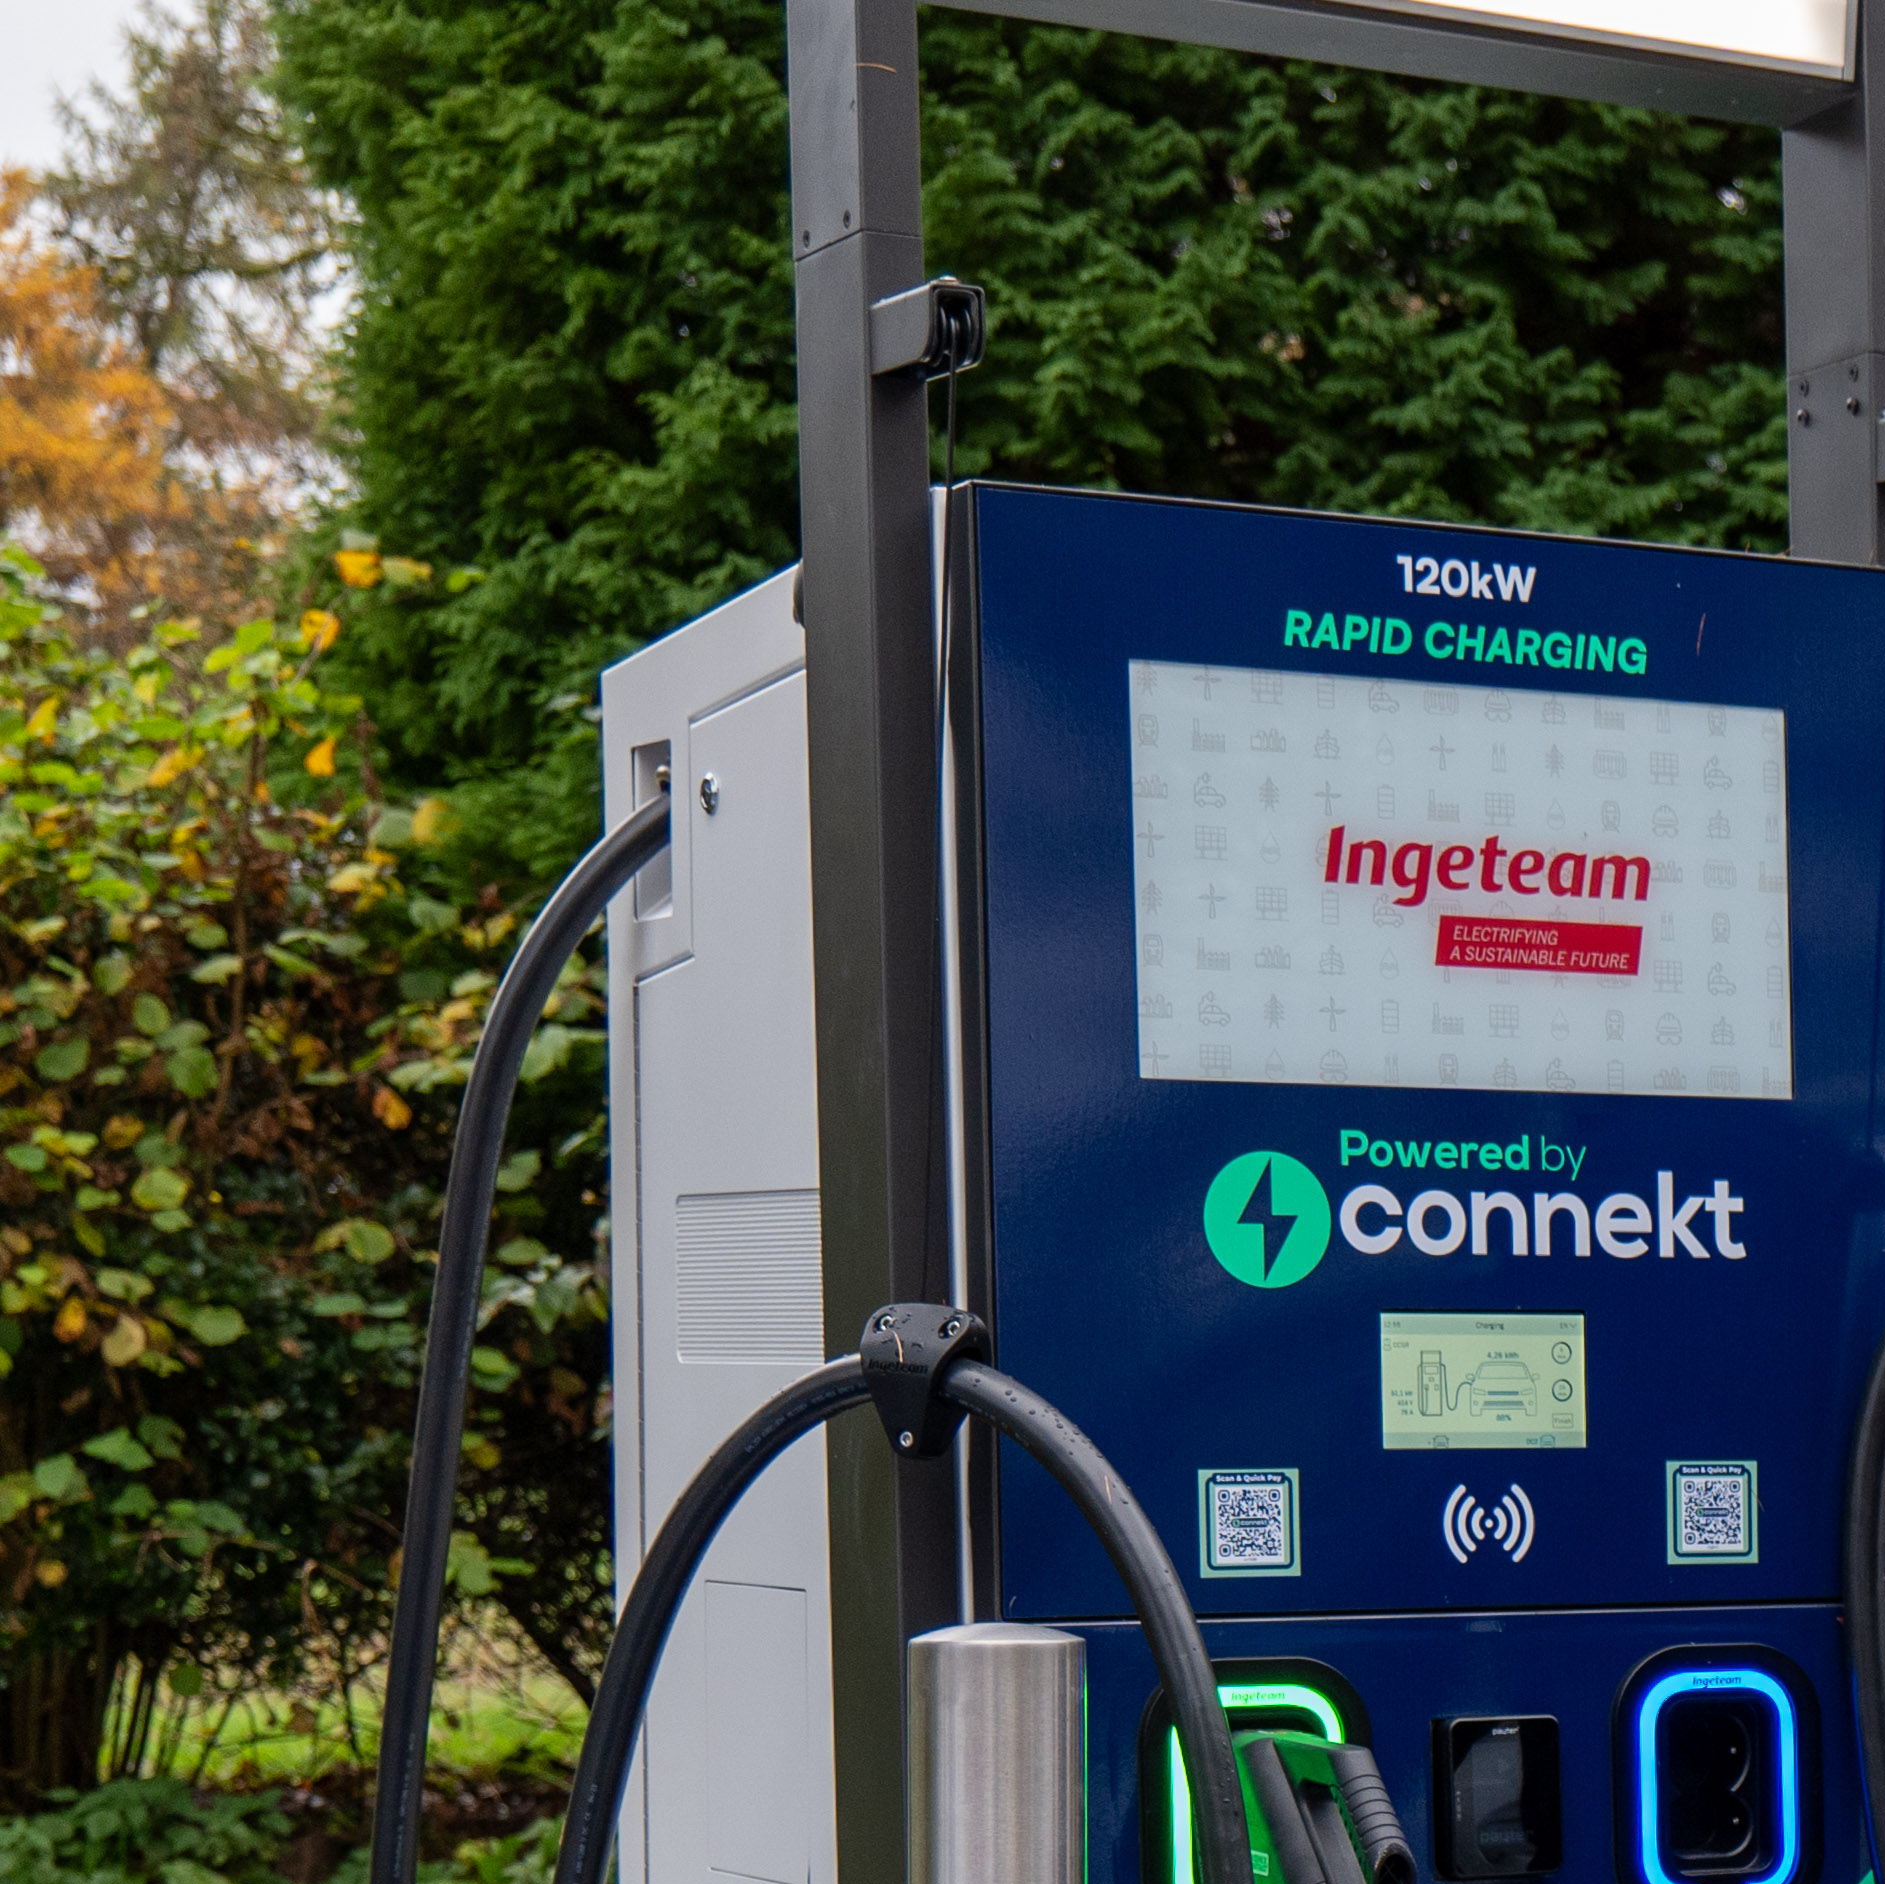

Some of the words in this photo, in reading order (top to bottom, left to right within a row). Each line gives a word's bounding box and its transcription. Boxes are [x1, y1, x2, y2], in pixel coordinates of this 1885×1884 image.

[1397, 555, 1537, 603] 120kW
[1283, 609, 1413, 655] RAPID
[1424, 621, 1648, 675] CHARGING
[1324, 825, 1651, 907] Ingeteam
[1452, 924, 1559, 946] ELECTRIFYING
[1449, 945, 1461, 961] A
[1464, 945, 1567, 967] SUSTAINABLE
[1570, 951, 1630, 970] FUTURE
[1340, 1129, 1530, 1171] Powered
[1540, 1134, 1588, 1182] by
[1340, 1171, 1747, 1260] connekt
[1475, 1321, 1505, 1331] Charging
[1215, 1474, 1235, 1483] Scan
[1243, 1474, 1266, 1484] Quick
[1267, 1474, 1282, 1483] Pay
[1682, 1466, 1700, 1474] Scan
[1706, 1466, 1728, 1475] Quick
[1729, 1466, 1742, 1475] Pay
[1692, 1676, 1742, 1689] Ingeteam
[1231, 1690, 1286, 1703] Ingeteam
